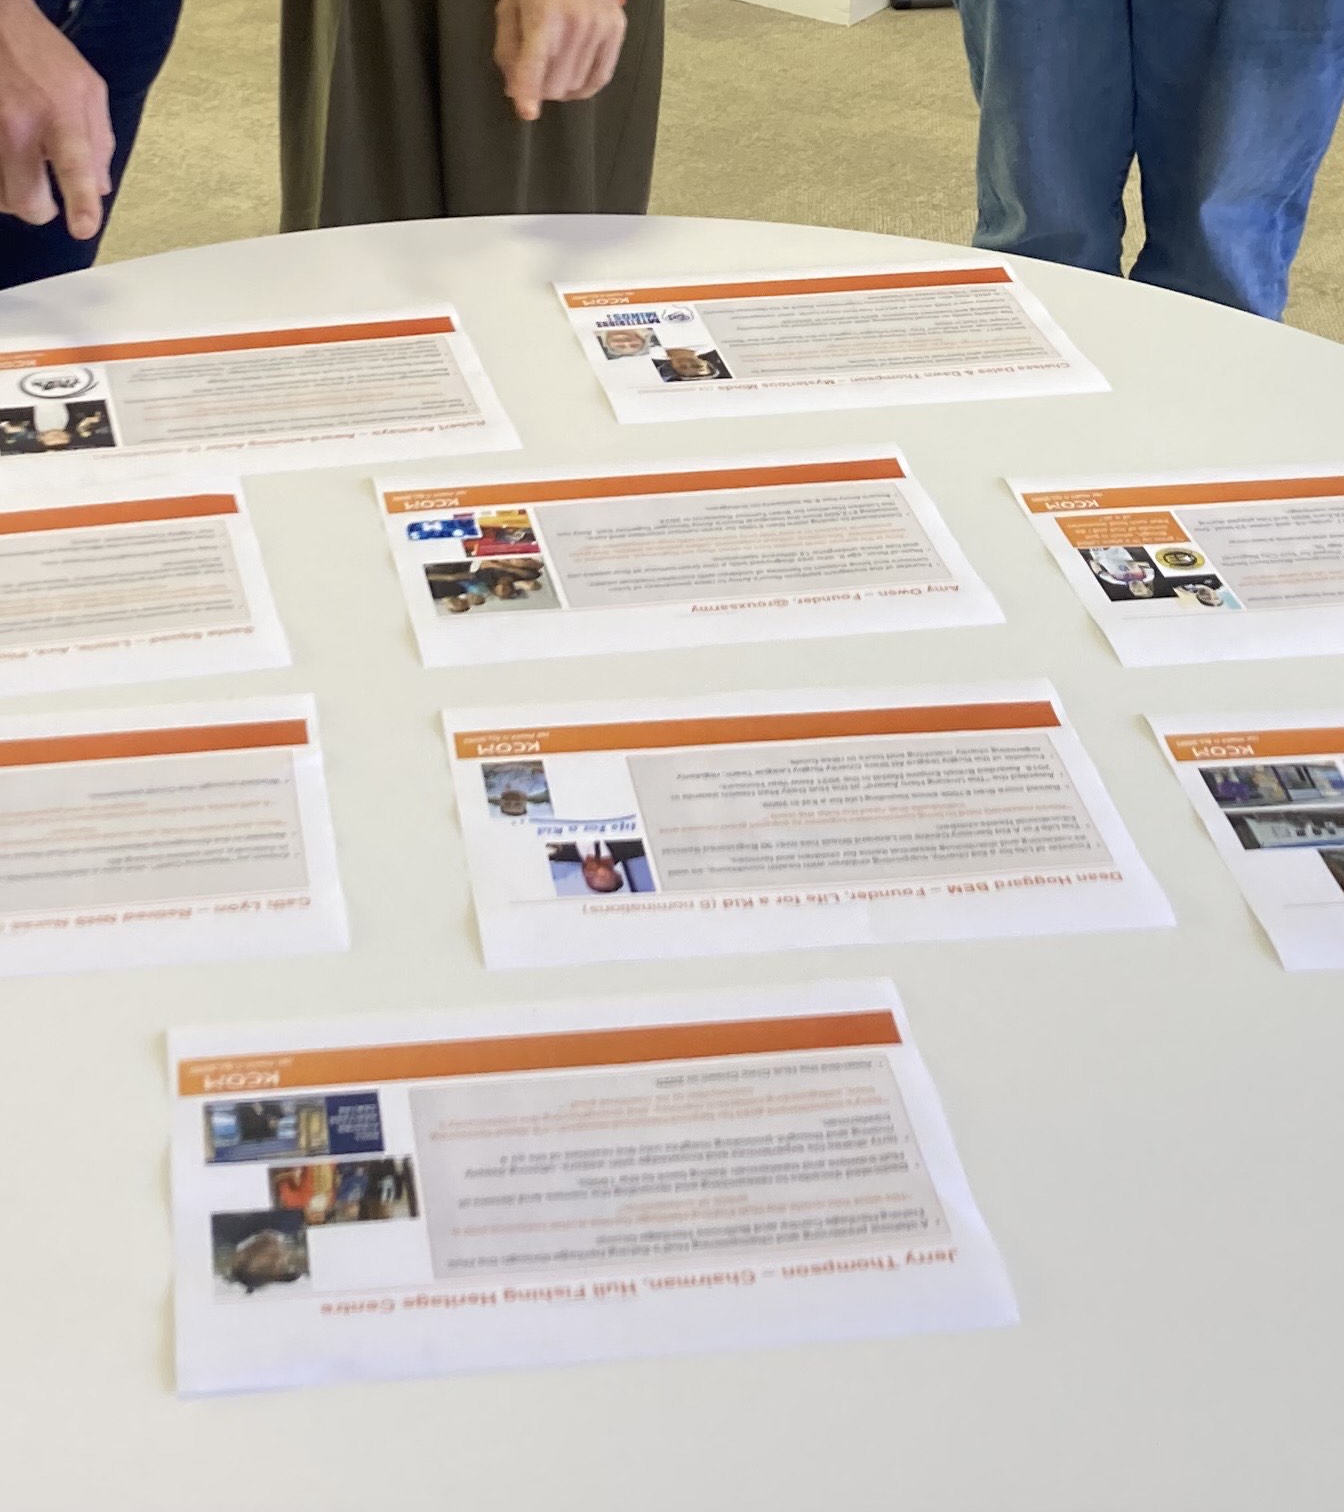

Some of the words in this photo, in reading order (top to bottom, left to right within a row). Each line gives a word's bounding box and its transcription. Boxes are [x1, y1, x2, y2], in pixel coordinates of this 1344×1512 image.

[582, 298, 631, 306] KCOM
[404, 498, 461, 510] KCOM
[1046, 500, 1099, 510] KCOM
[477, 741, 541, 755] KCOM
[1193, 744, 1255, 758] KCOM
[993, 873, 1072, 891] Hoggard
[1076, 872, 1123, 885] Dean
[844, 886, 926, 901] Founder,
[946, 881, 990, 895] BEM
[722, 897, 755, 909] Kid
[775, 894, 802, 906] for
[806, 892, 841, 904] Life
[204, 1070, 281, 1091] KCOM
[905, 1247, 961, 1269] Jerry
[780, 1254, 899, 1281] Thompson
[642, 1268, 756, 1294] Chairman,
[503, 1281, 586, 1306] Fishing
[592, 1280, 637, 1300] Hull
[403, 1287, 496, 1314] Heritage
[319, 1297, 396, 1319] Centre
